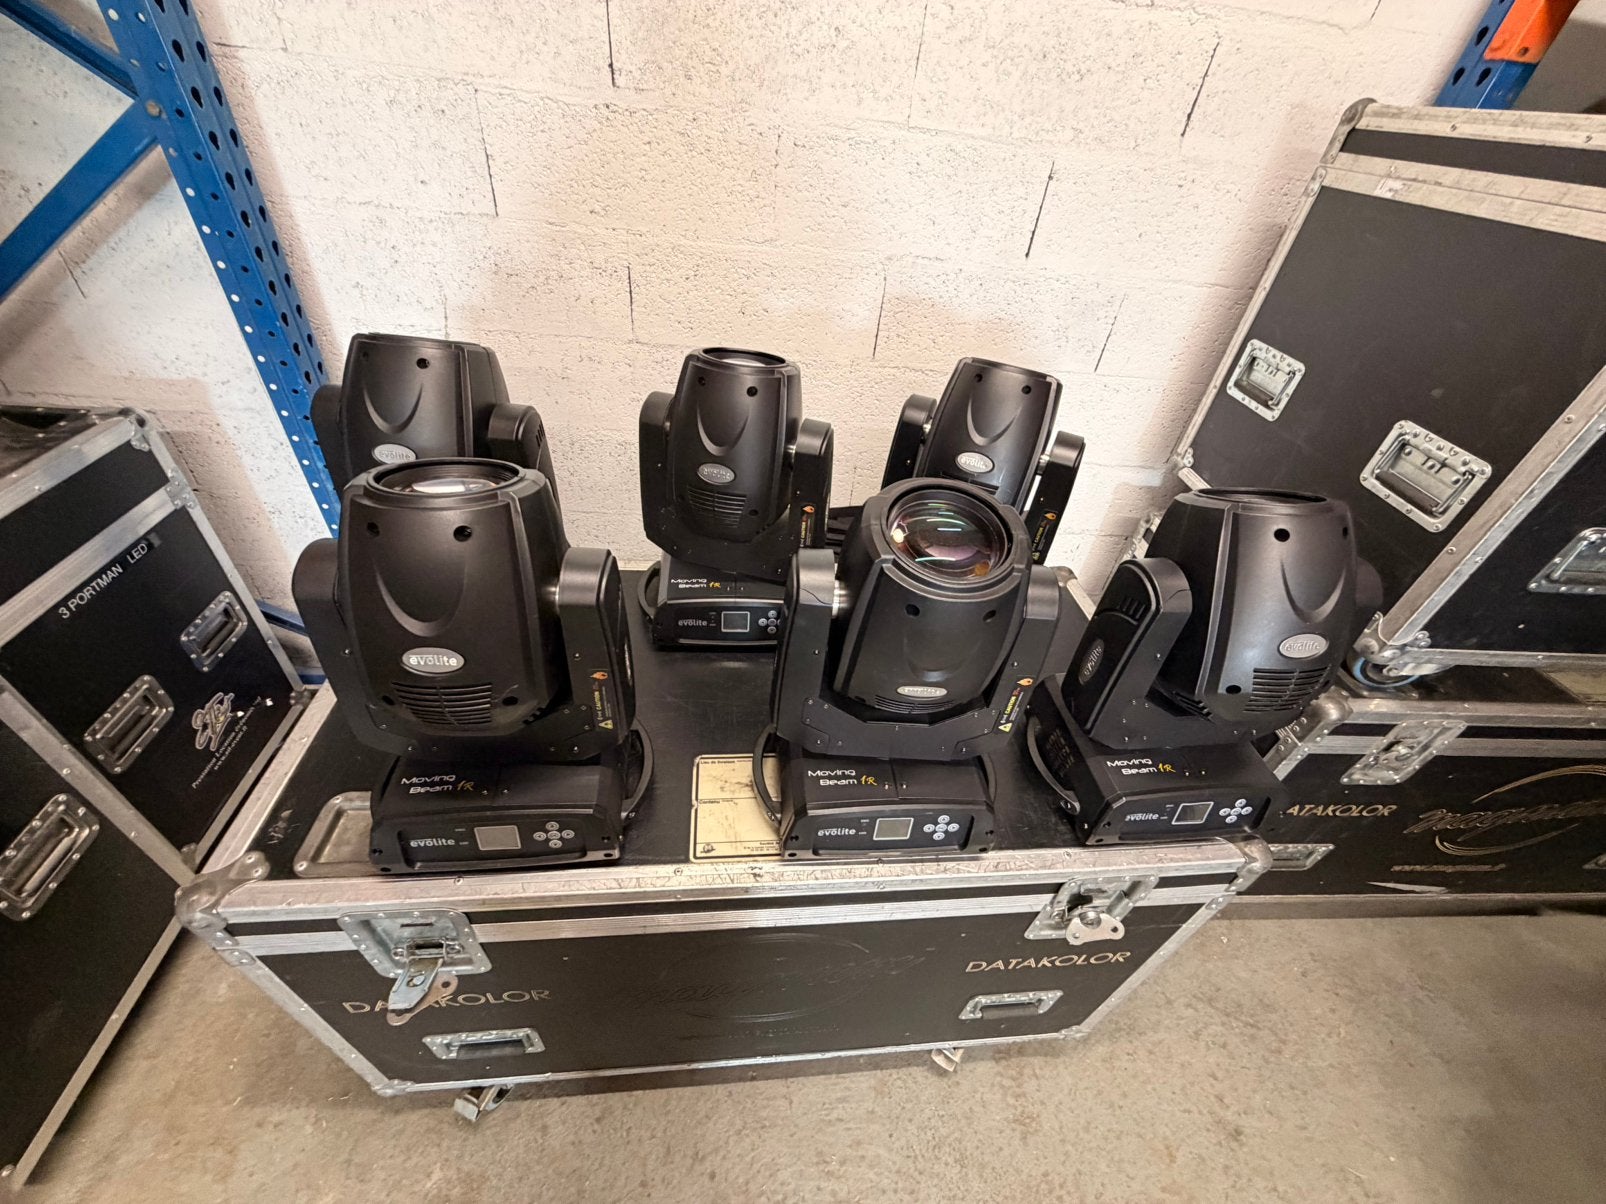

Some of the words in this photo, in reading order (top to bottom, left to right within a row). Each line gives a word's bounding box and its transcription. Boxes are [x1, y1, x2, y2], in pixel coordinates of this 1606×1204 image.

[58, 607, 71, 619] 3
[67, 563, 124, 612] PORTMAN
[126, 543, 149, 564] LED
[678, 618, 708, 627] evolite
[408, 654, 458, 666] evolite
[1106, 758, 1153, 767] Moving
[1121, 767, 1158, 775] Beam
[1158, 762, 1176, 773] 1R
[807, 769, 857, 777] Moving
[400, 774, 457, 785] Moving
[860, 774, 878, 786] 1R
[408, 784, 454, 794] Beam
[456, 780, 475, 791] 1R
[1286, 804, 1398, 816] ATAKOLOR
[817, 827, 857, 837] evolite
[409, 838, 456, 848] evolite
[965, 951, 1132, 973] DATAKOLOR
[342, 989, 551, 1014] DAKOLOR
